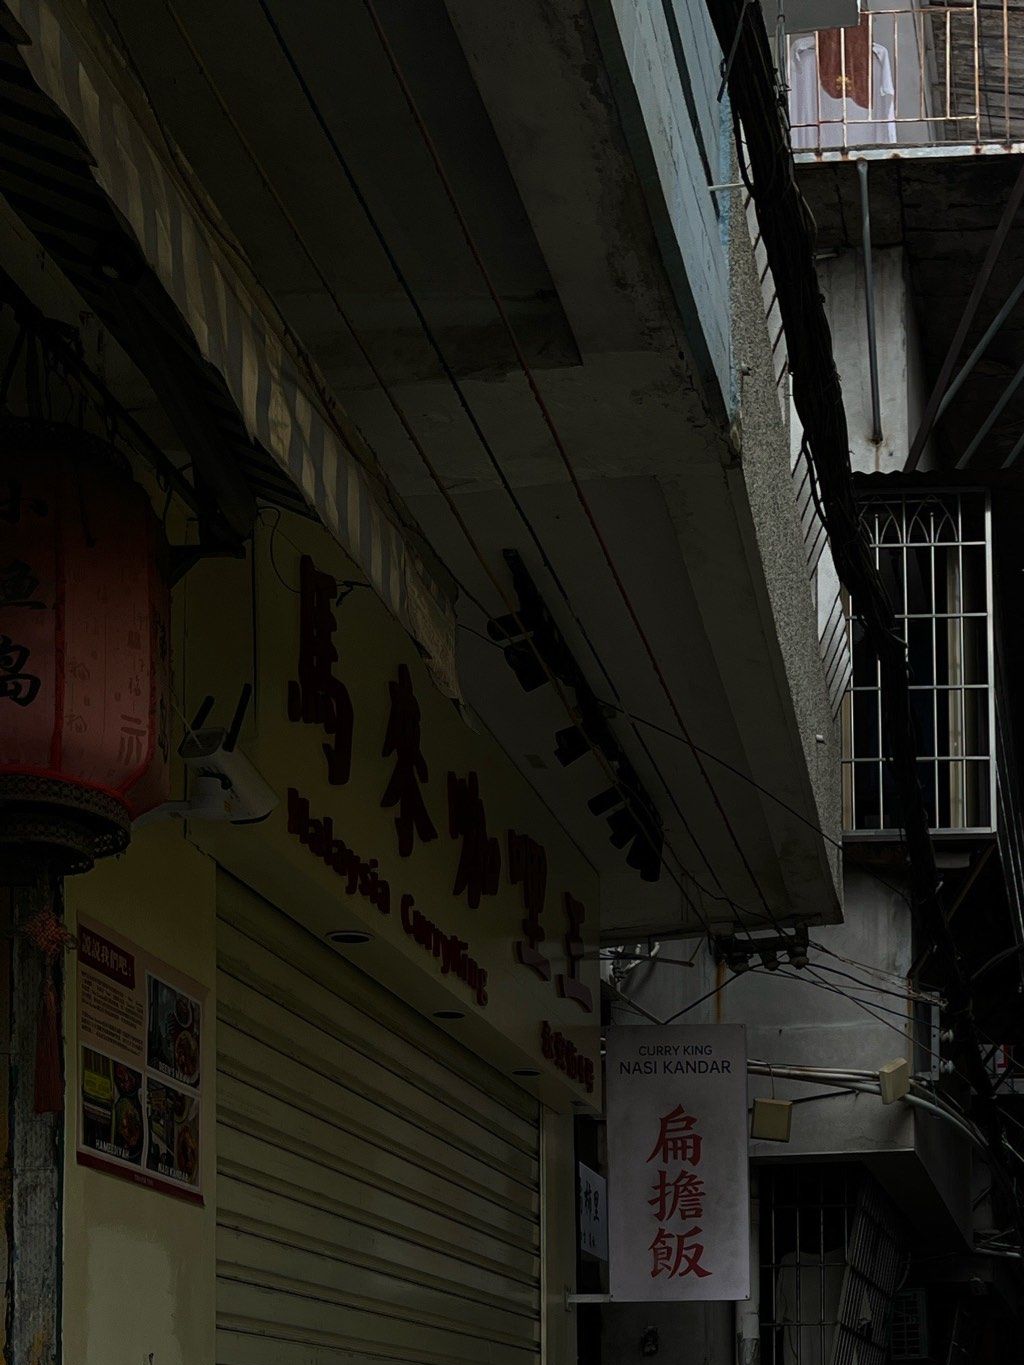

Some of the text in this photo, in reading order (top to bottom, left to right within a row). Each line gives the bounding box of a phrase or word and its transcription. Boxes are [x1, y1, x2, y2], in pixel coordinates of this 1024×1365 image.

[287, 787, 391, 914] Malaysia
[619, 1060, 732, 1075] NASI KANDAR
[638, 1045, 713, 1057] CURRY KING
[646, 1103, 713, 1279] 扁擔飯
